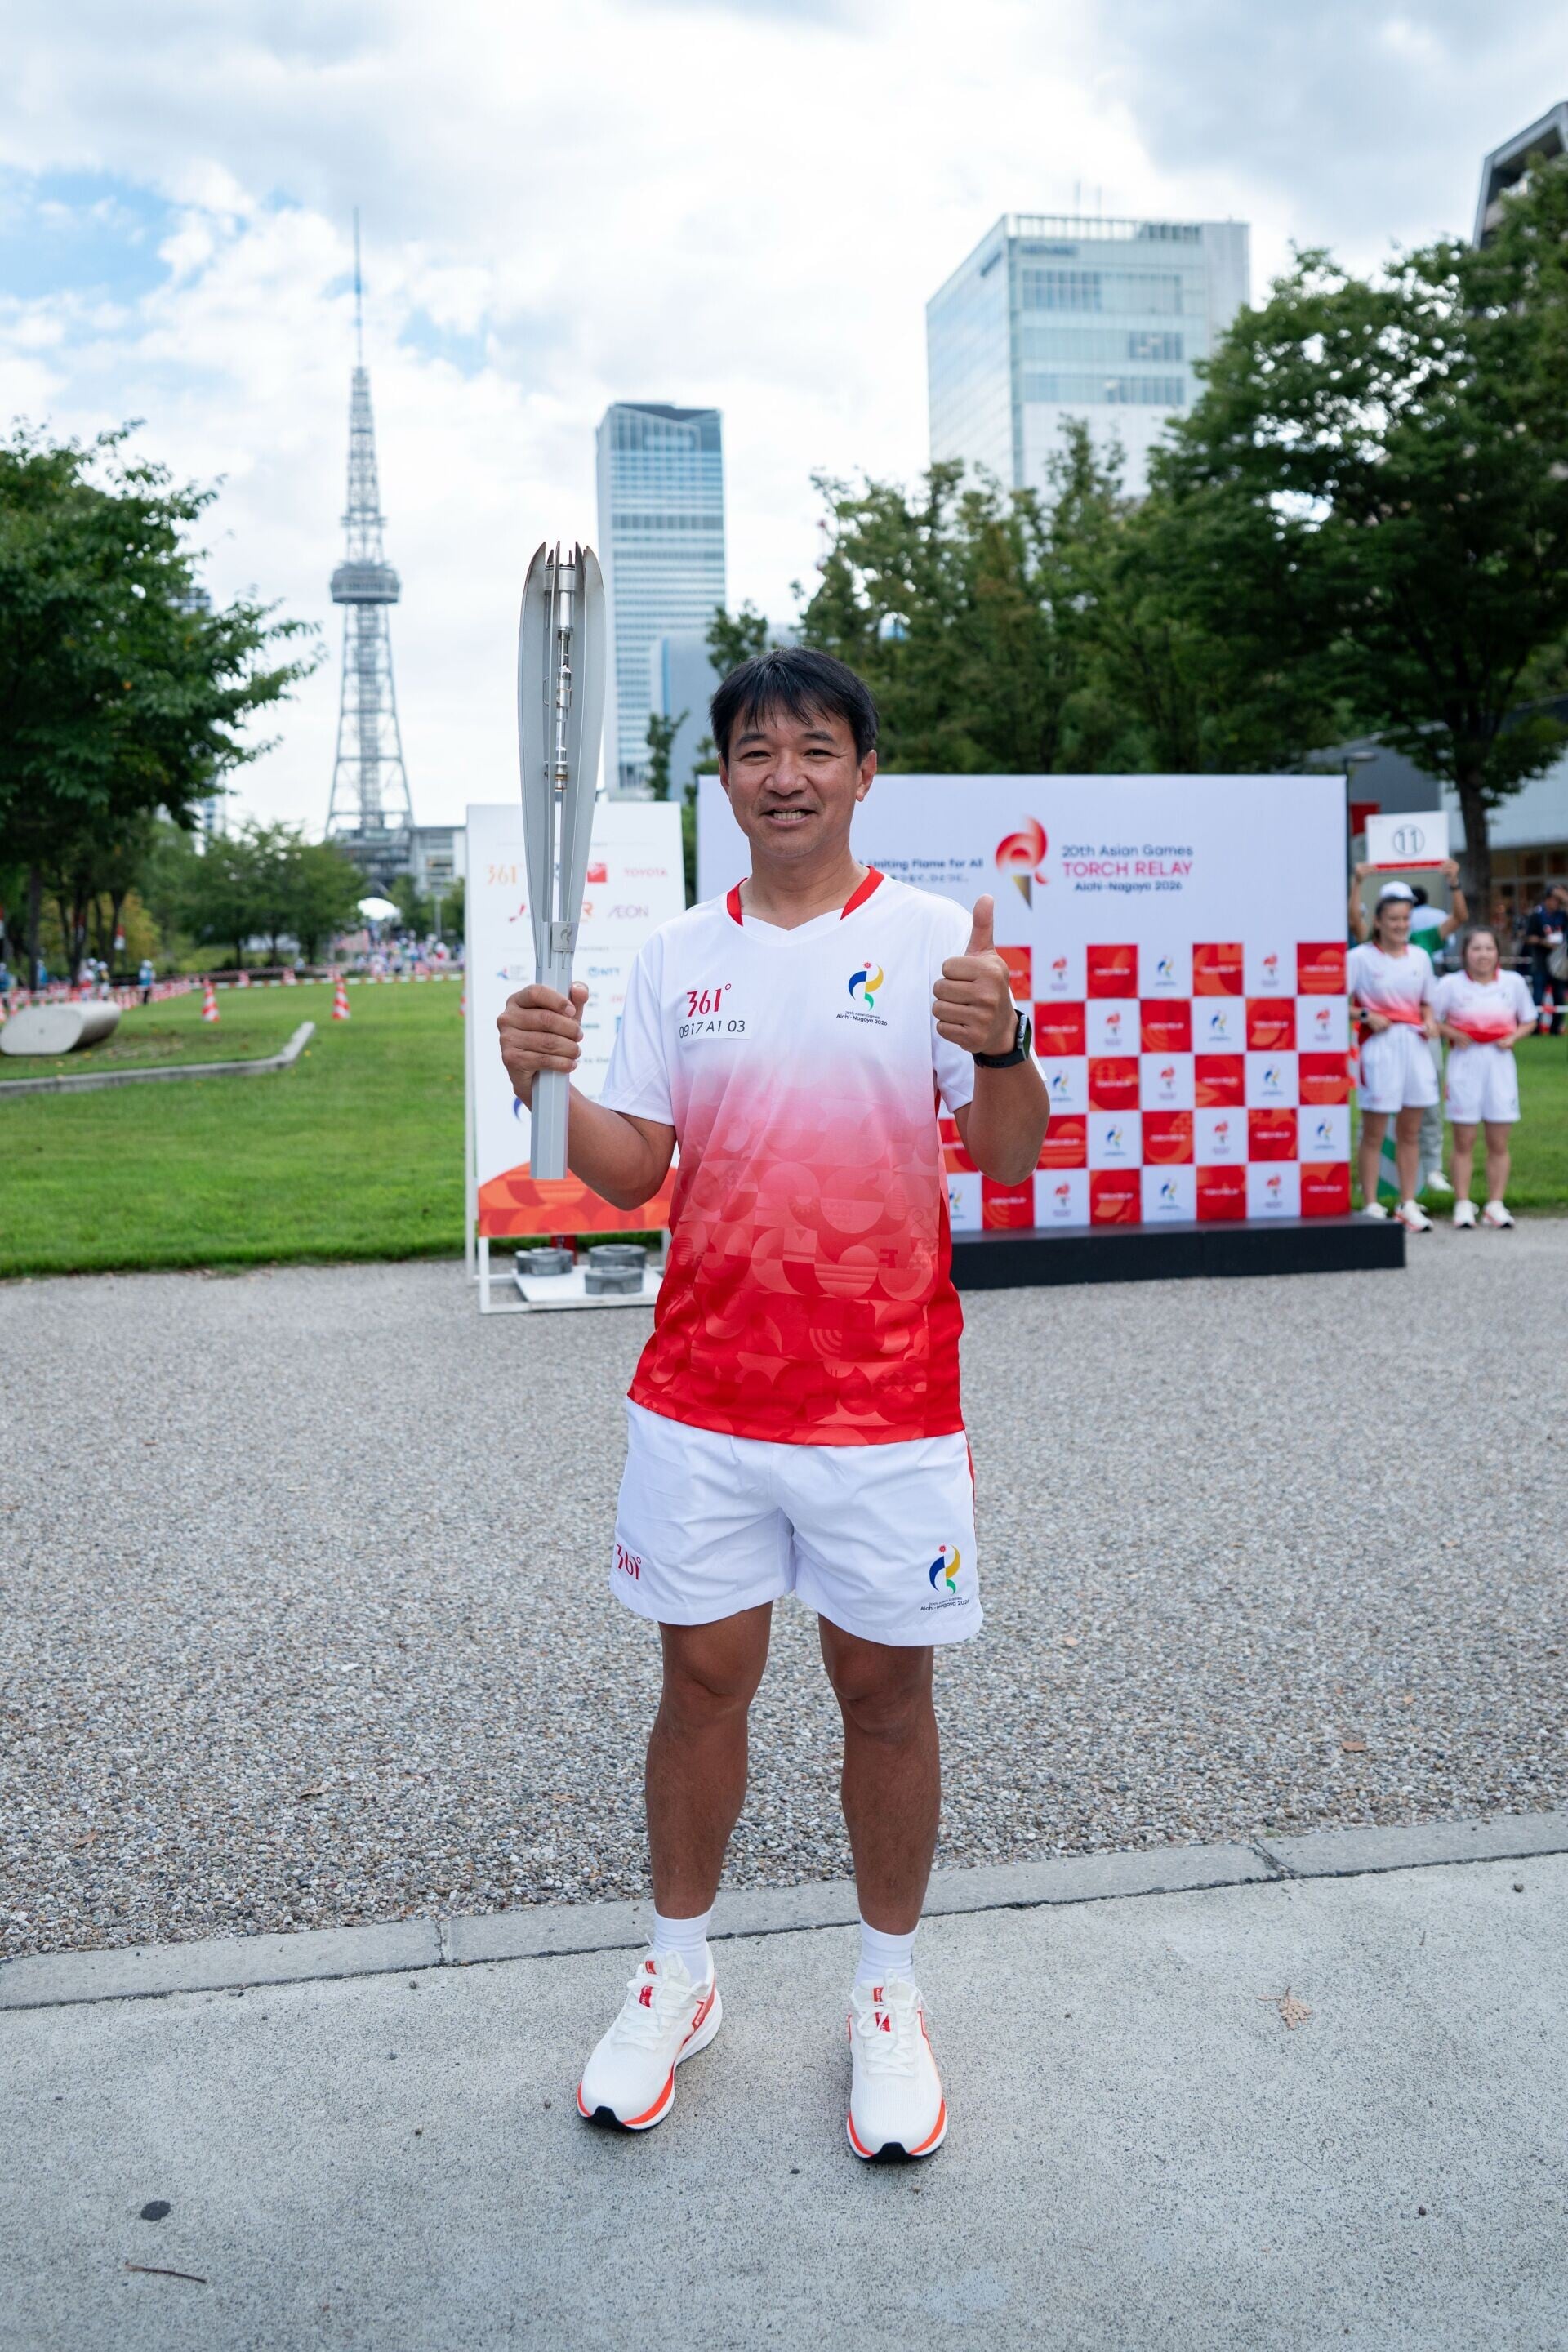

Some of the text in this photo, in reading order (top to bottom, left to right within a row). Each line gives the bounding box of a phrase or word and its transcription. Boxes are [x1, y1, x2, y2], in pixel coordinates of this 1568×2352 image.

[1062, 844, 1193, 858] 20th Asian Games
[913, 858, 946, 868] Flame
[950, 858, 965, 868] for
[1062, 861, 1192, 876] TORCH RELAY
[623, 868, 667, 877] TOYOTA
[1075, 880, 1183, 893] Aichi-Nagoya 2026
[835, 1013, 874, 1024] Aichi-Nagoya
[679, 1020, 746, 1039] 0917 A1 03
